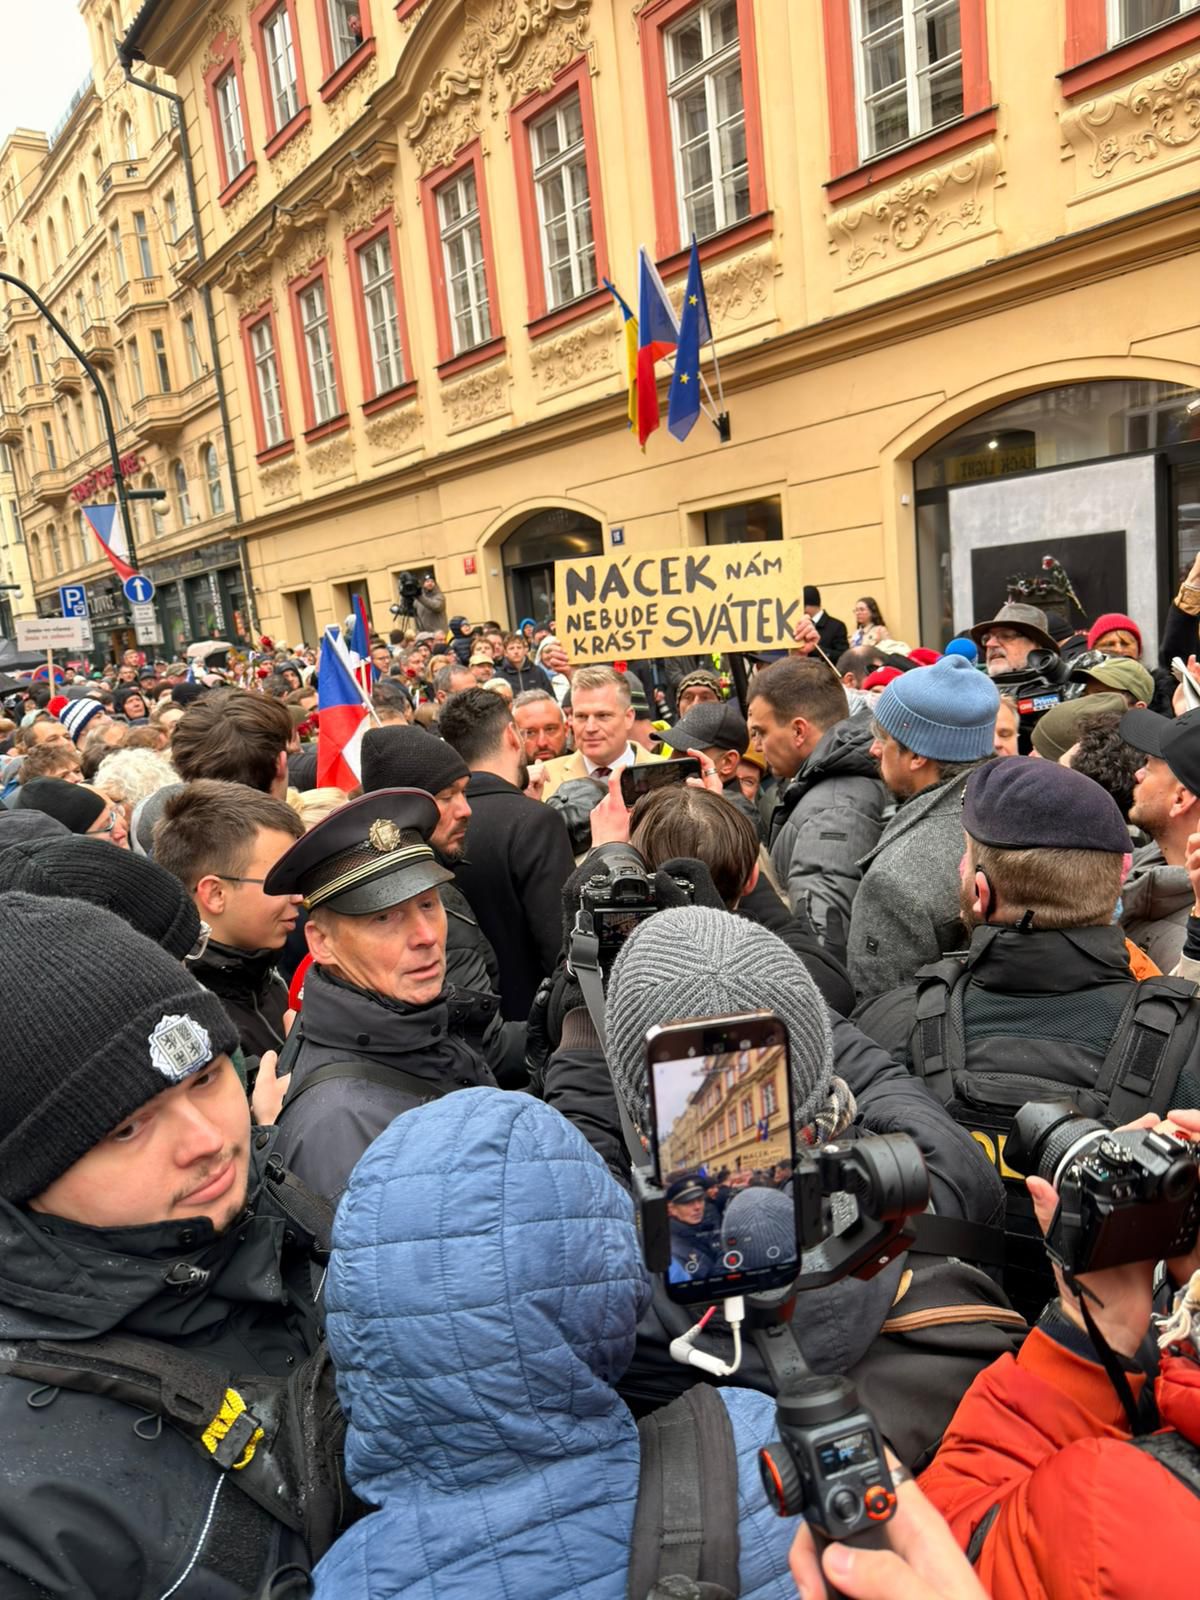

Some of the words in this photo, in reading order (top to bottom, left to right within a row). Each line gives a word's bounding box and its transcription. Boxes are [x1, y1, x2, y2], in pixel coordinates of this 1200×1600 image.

[566, 555, 717, 605] NÁCEK
[726, 551, 782, 580] NÁM
[65, 589, 80, 608] P
[567, 603, 659, 633] NEBUDE
[662, 593, 801, 647] SVÁTEK
[573, 629, 653, 656] KRÁST
